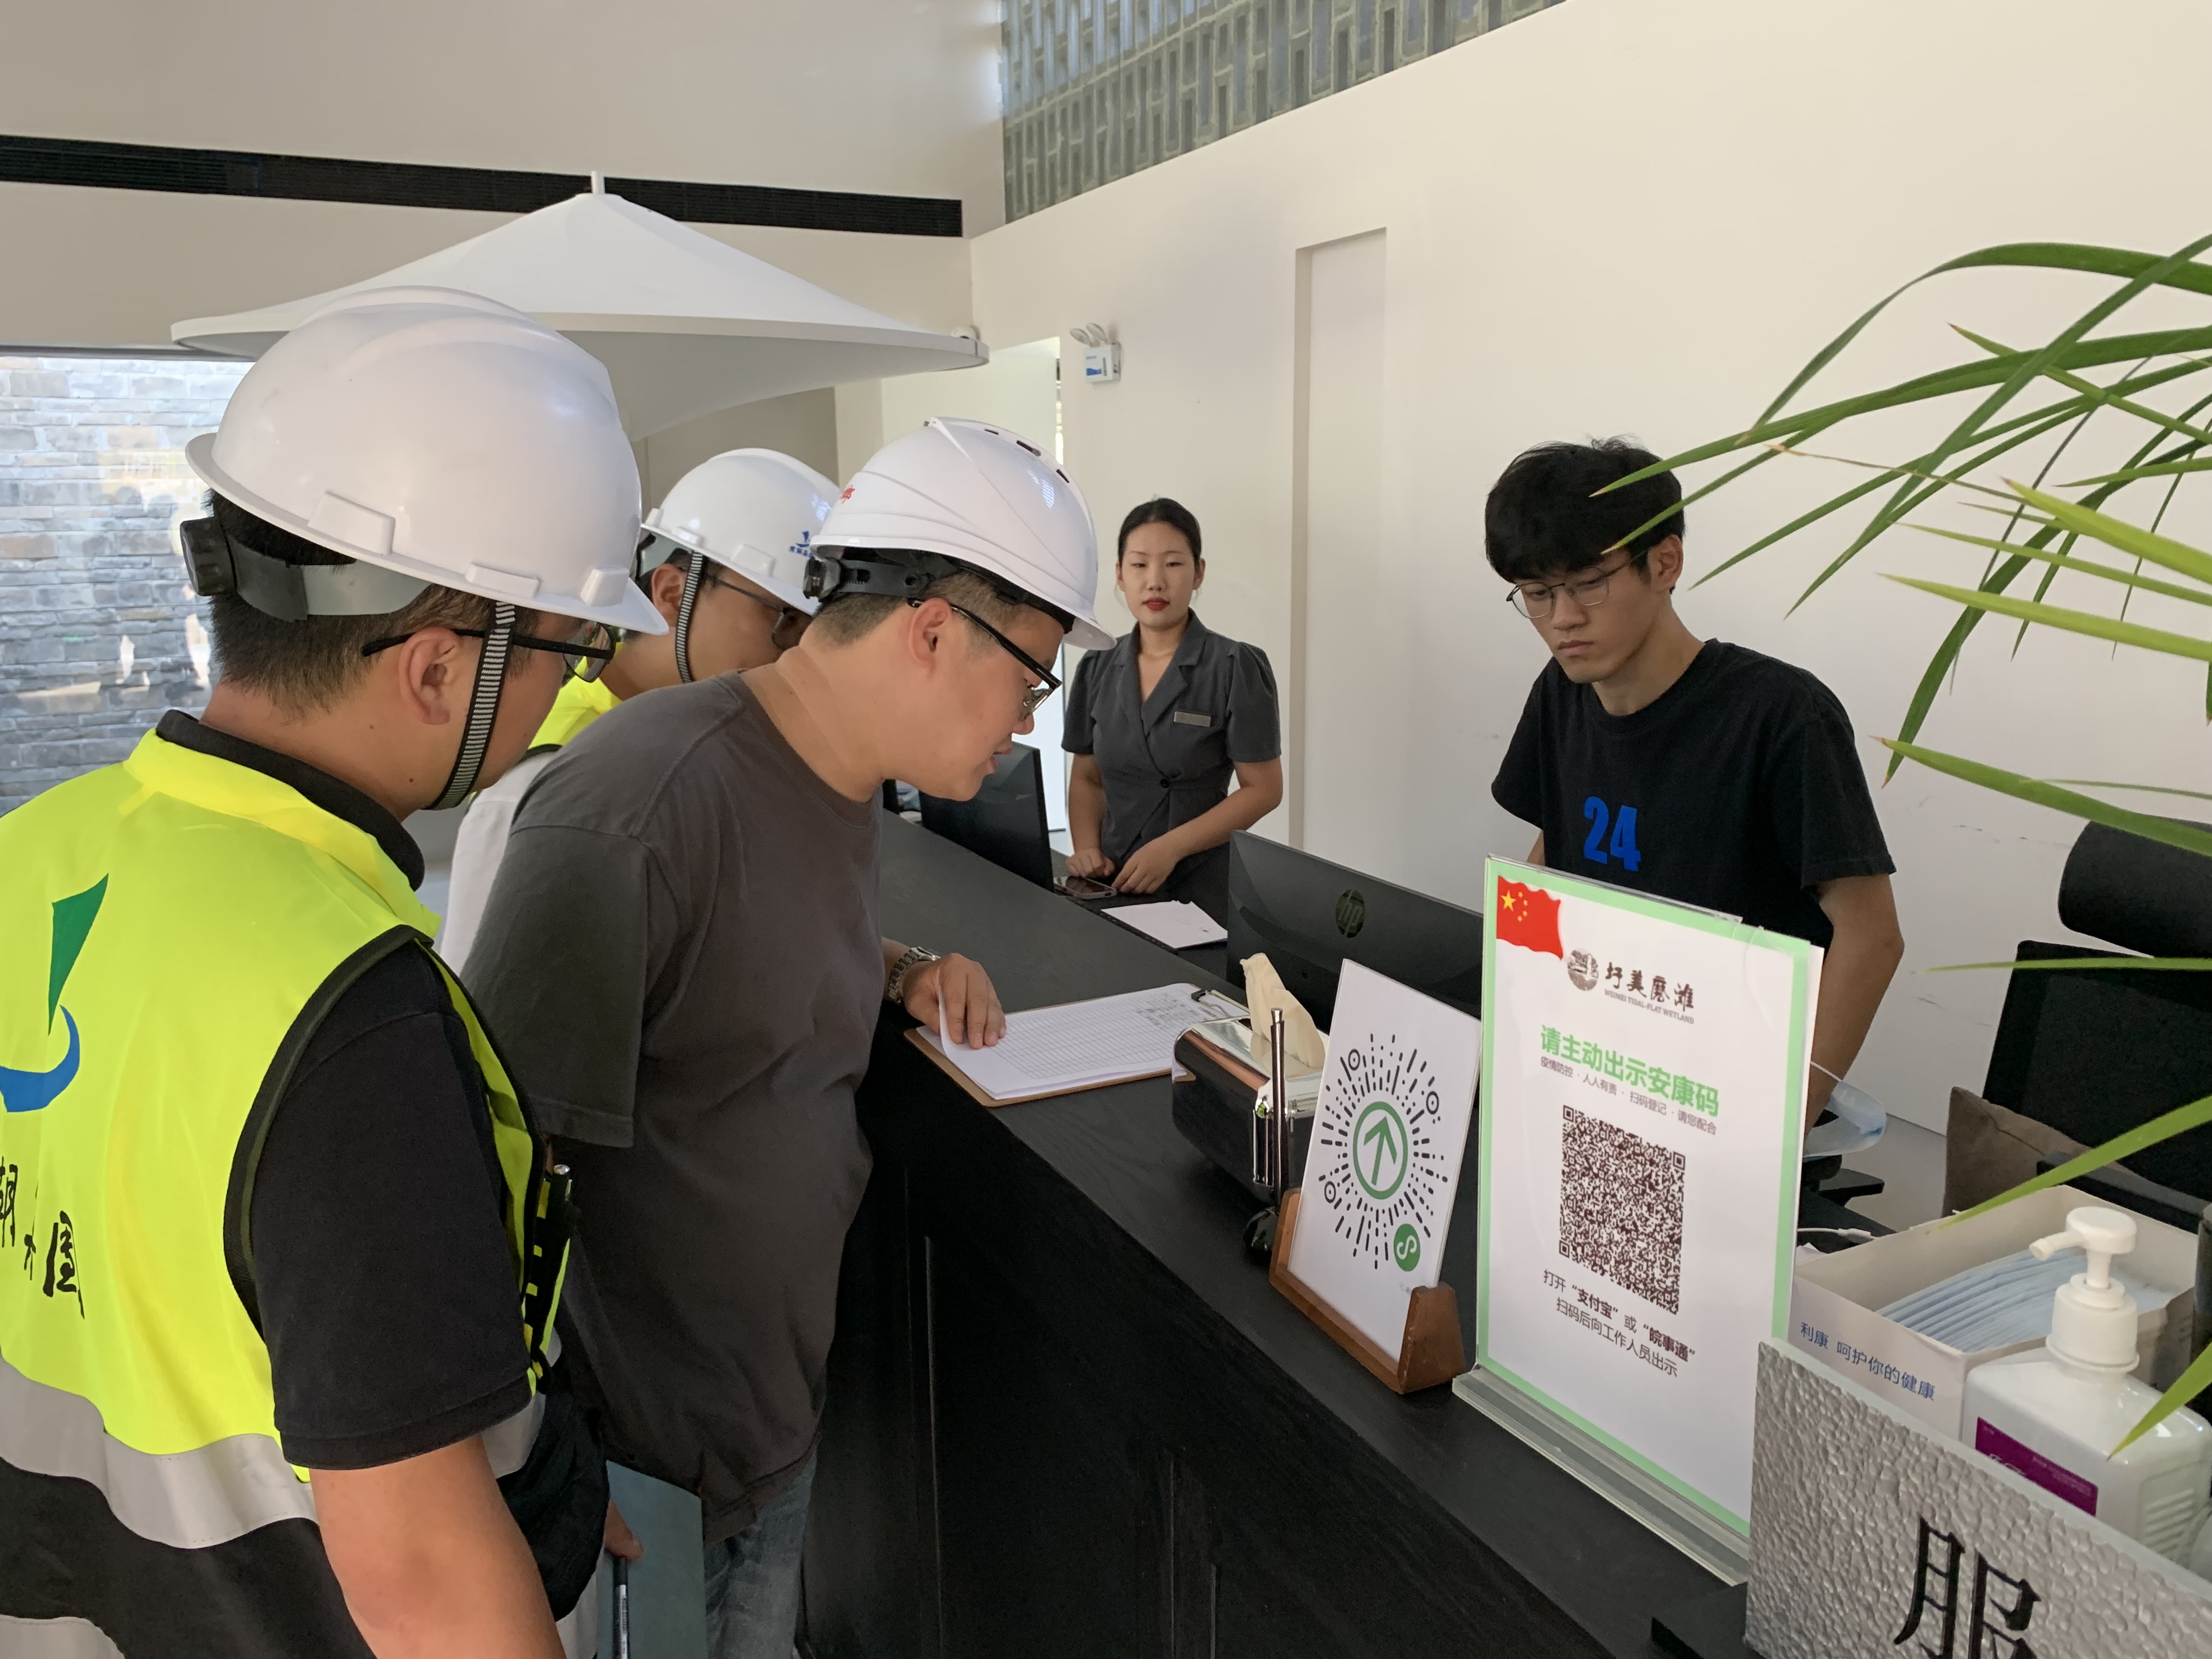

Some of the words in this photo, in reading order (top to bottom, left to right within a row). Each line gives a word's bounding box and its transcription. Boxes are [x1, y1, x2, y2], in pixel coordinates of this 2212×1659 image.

[1583, 796, 1641, 872] 24
[1604, 989, 1626, 1002] WEIMEI
[1628, 997, 1662, 1014] TIDAL-FLAT
[1663, 1008, 1694, 1024] WETLAND
[1541, 1024, 1719, 1117] 请主动出示安康码
[1541, 1057, 1573, 1077] 疫情防控
[1583, 1073, 1617, 1096] 人人有责
[1630, 1091, 1667, 1115] 扫码登记
[1678, 1109, 1717, 1135] 请您配合
[1556, 1297, 1677, 1377] 扫码后向工作人员出示
[1801, 1322, 1829, 1350] 利康
[1837, 1341, 1936, 1401] 呵护你的健康
[1893, 1511, 2042, 1659] 服
